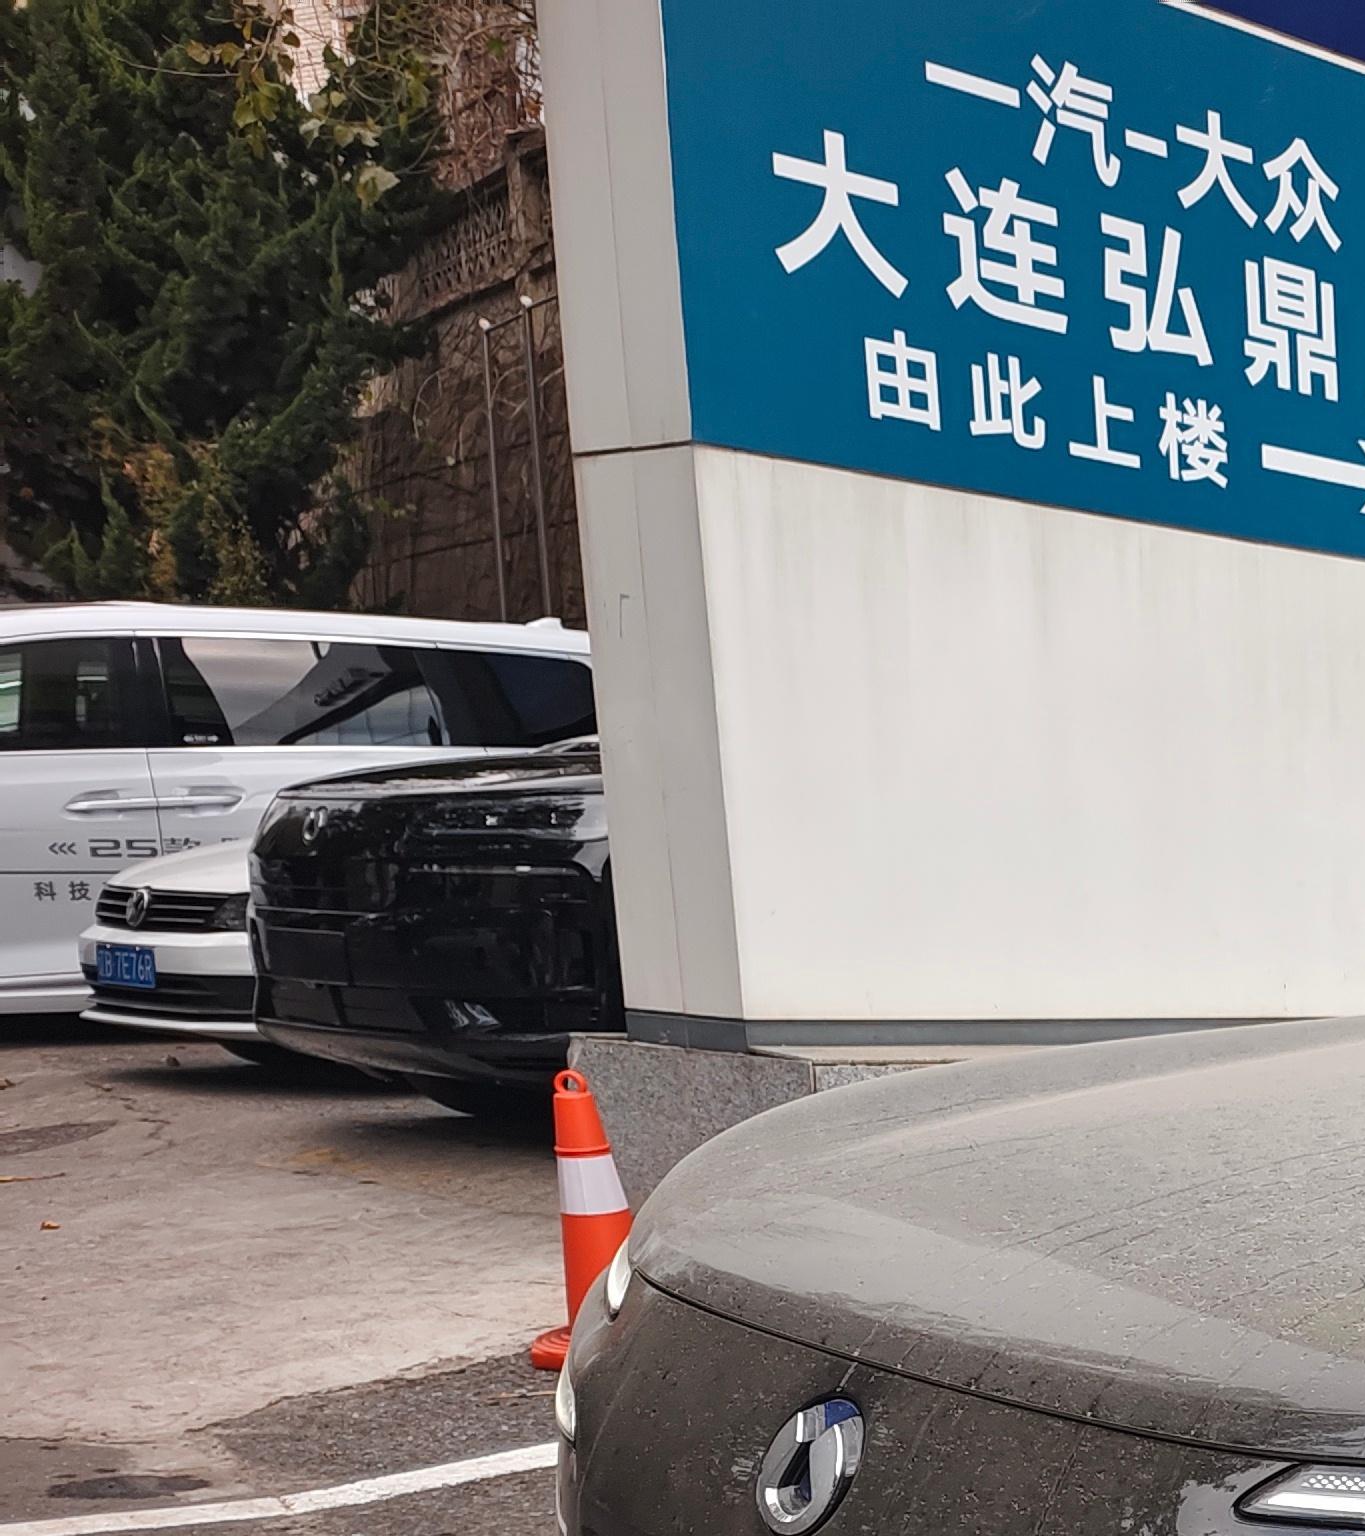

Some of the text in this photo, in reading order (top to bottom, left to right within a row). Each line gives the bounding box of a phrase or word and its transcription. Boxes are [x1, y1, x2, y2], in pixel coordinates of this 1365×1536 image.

[925, 54, 1341, 252] 一汽-大众
[864, 329, 1228, 488] 由此上楼
[34, 881, 92, 902] 科技
